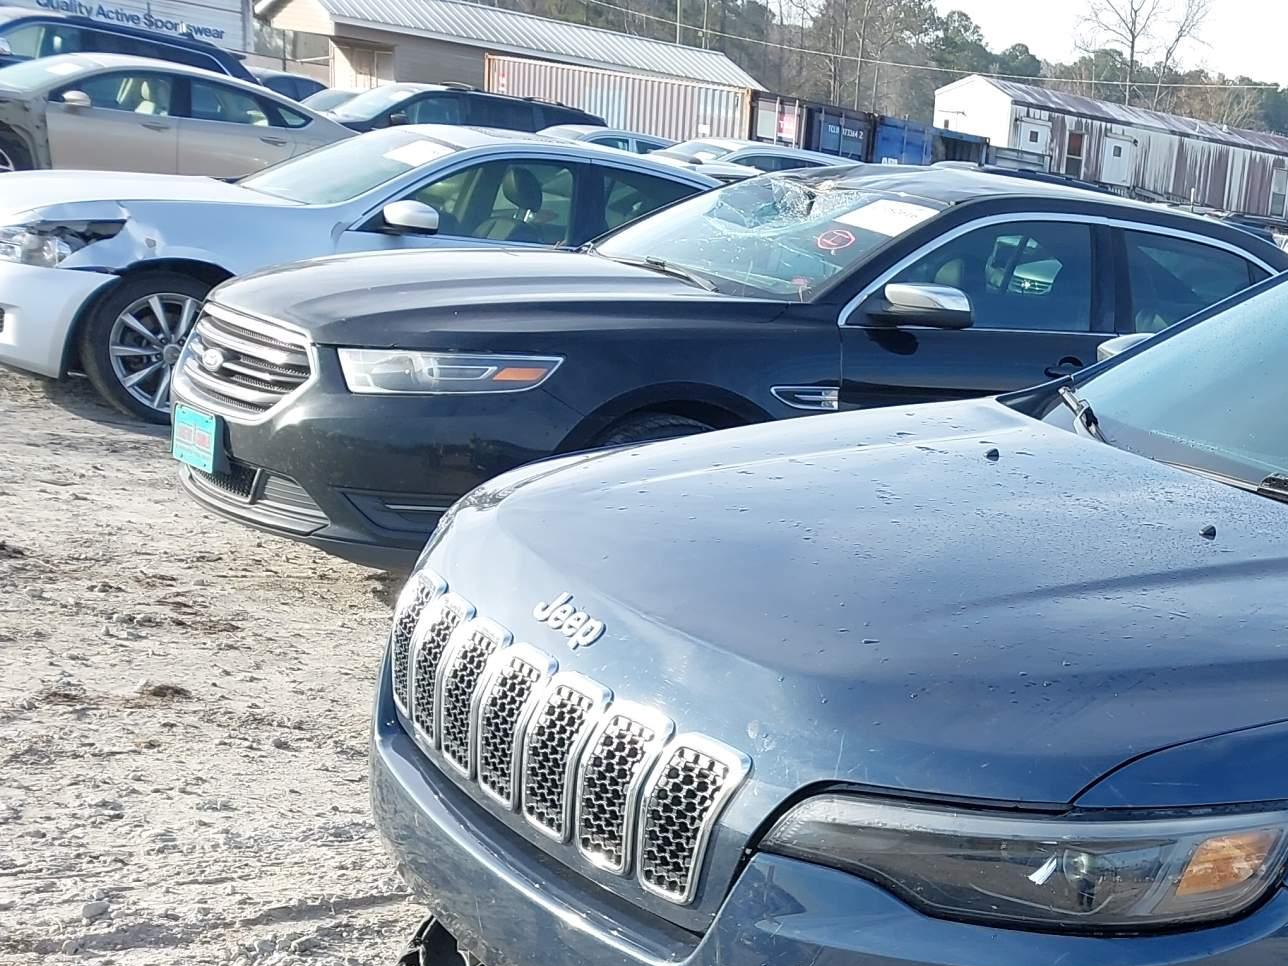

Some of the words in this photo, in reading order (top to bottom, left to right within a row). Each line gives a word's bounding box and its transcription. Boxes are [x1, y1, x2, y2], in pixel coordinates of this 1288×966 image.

[36, 0, 94, 17] Quality
[96, 4, 140, 25] Active
[533, 591, 607, 651] Jeep
